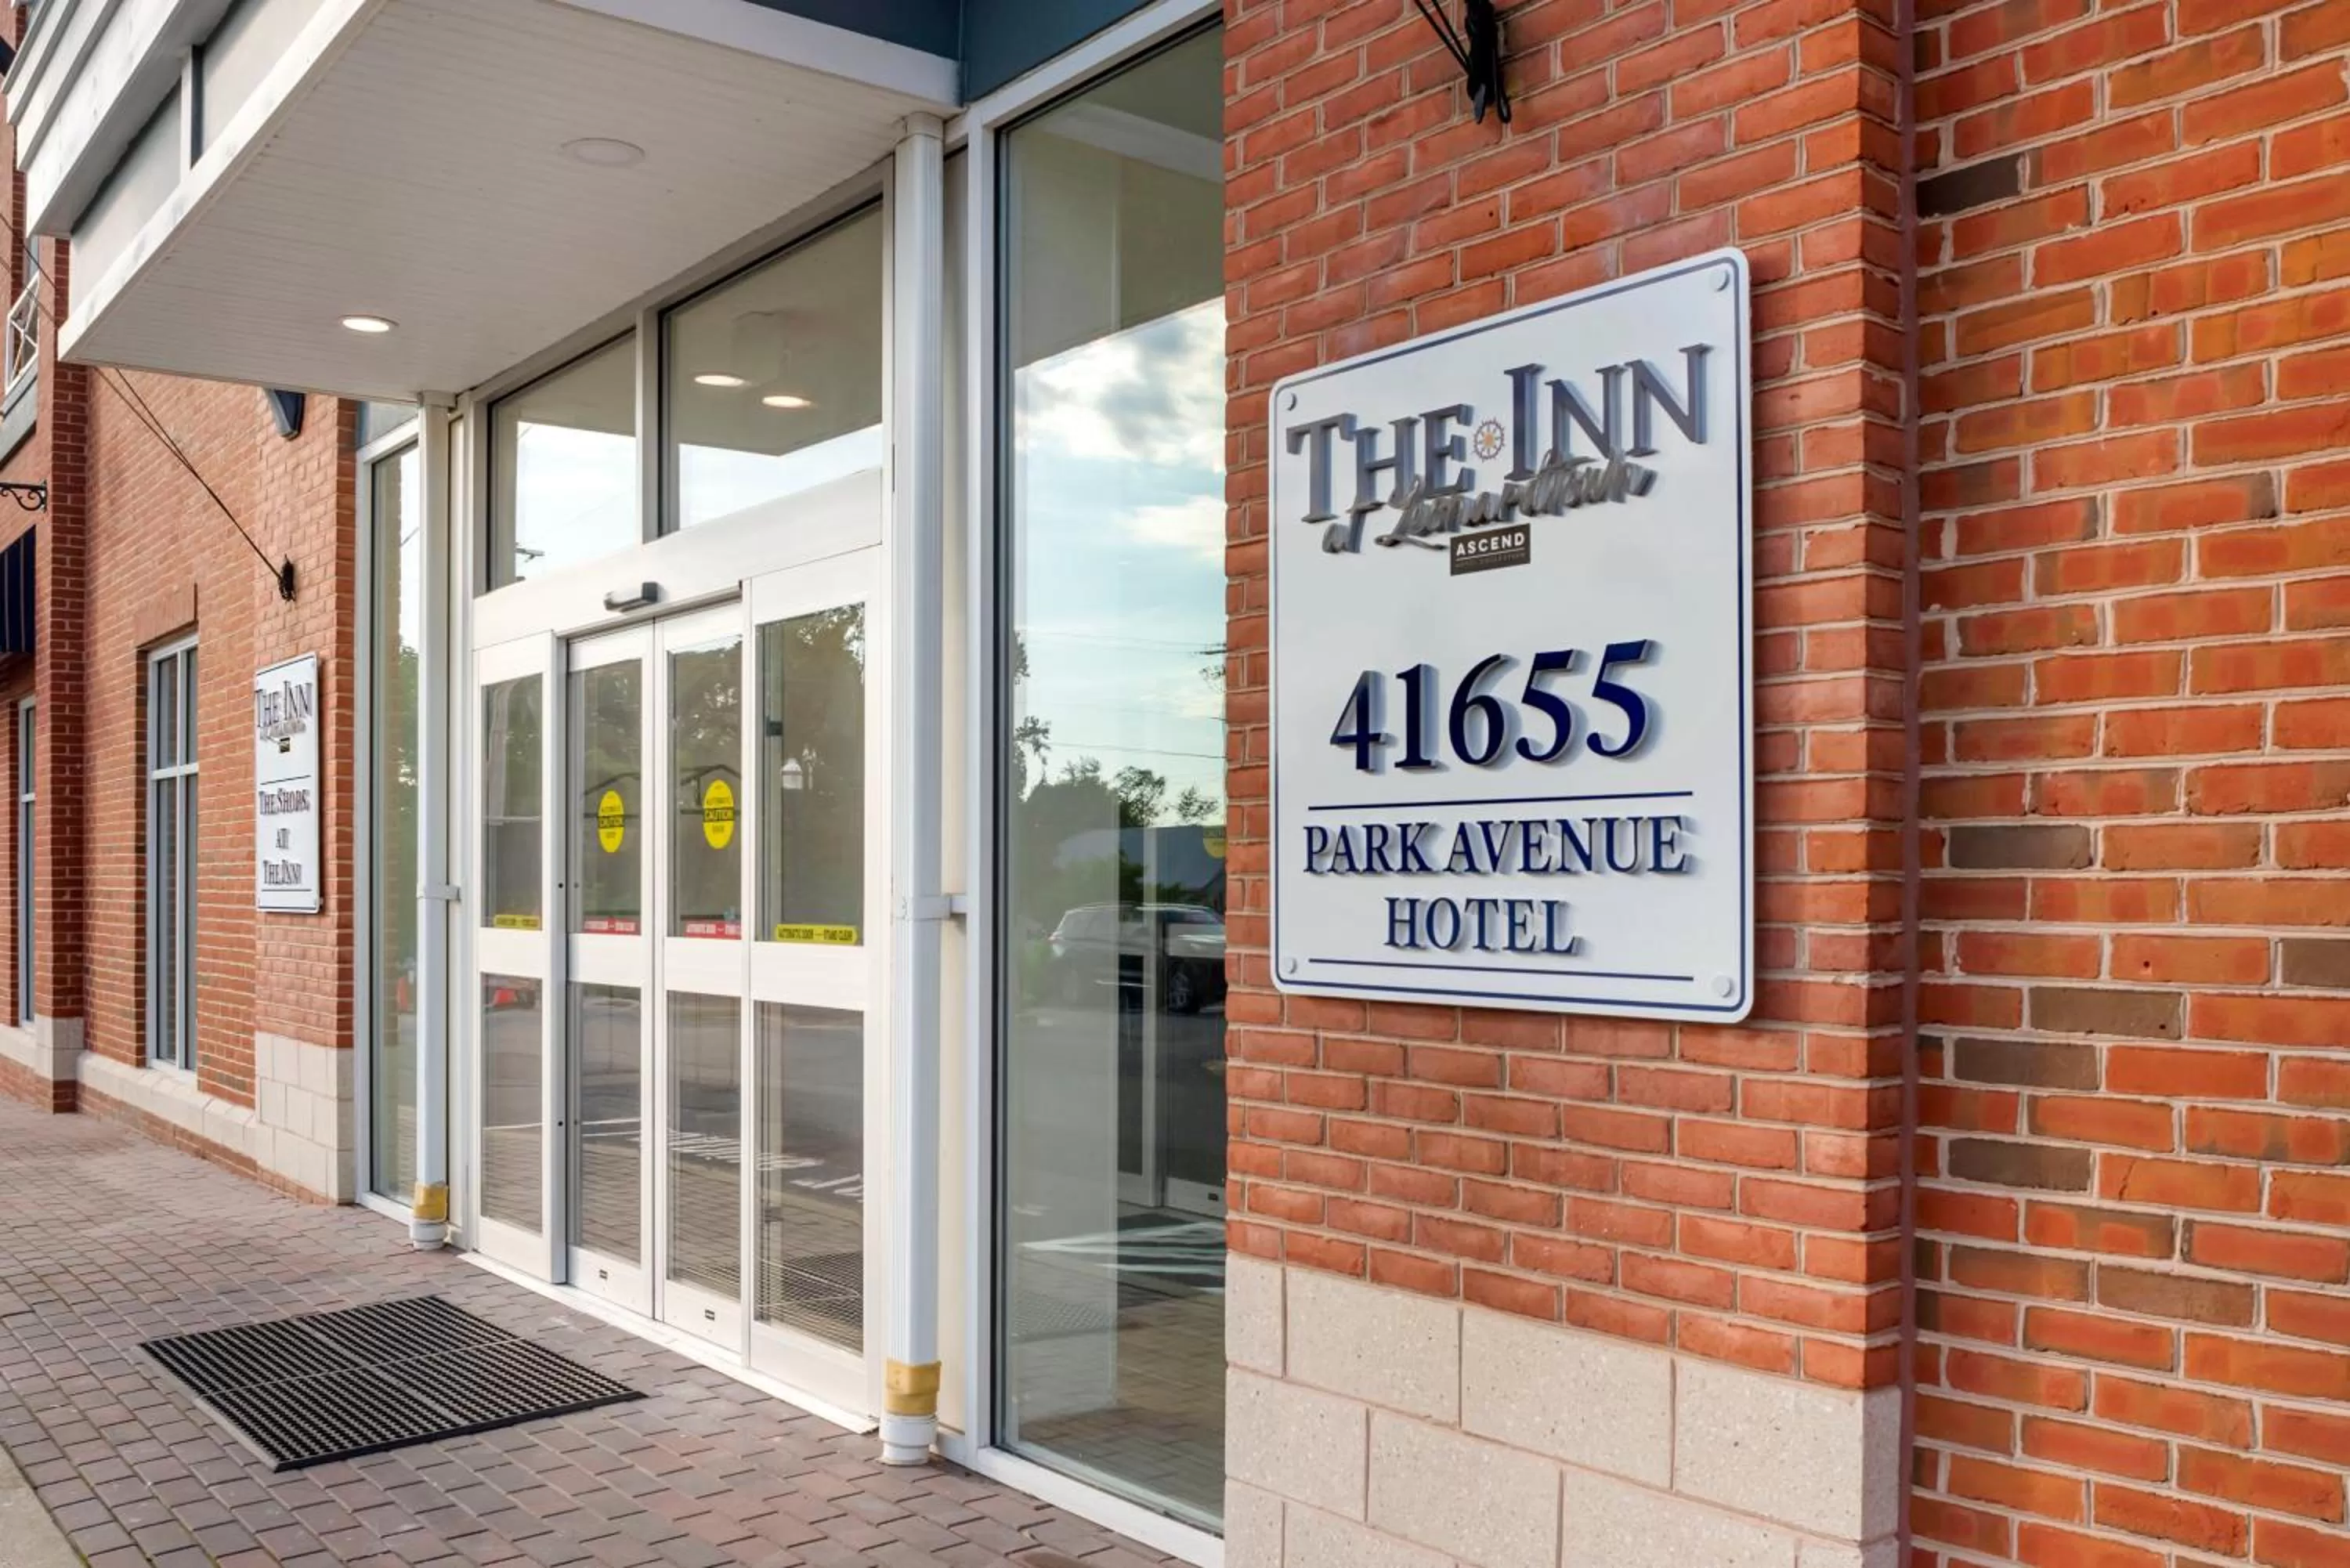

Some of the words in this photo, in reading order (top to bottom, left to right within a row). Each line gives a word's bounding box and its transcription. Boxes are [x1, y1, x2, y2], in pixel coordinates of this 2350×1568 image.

[1285, 402, 1474, 523] THE
[1503, 342, 1713, 482] INN
[1456, 532, 1525, 557] ASCEND
[254, 688, 281, 728] THE
[283, 680, 313, 721] INN
[1329, 638, 1658, 771] 41655
[258, 789, 277, 815] THE
[277, 787, 311, 815] SHOPS
[1303, 820, 1437, 875] PARK
[1442, 814, 1690, 875] AVENUE
[263, 858, 280, 885] THE
[1383, 896, 1581, 954] HOTEL
